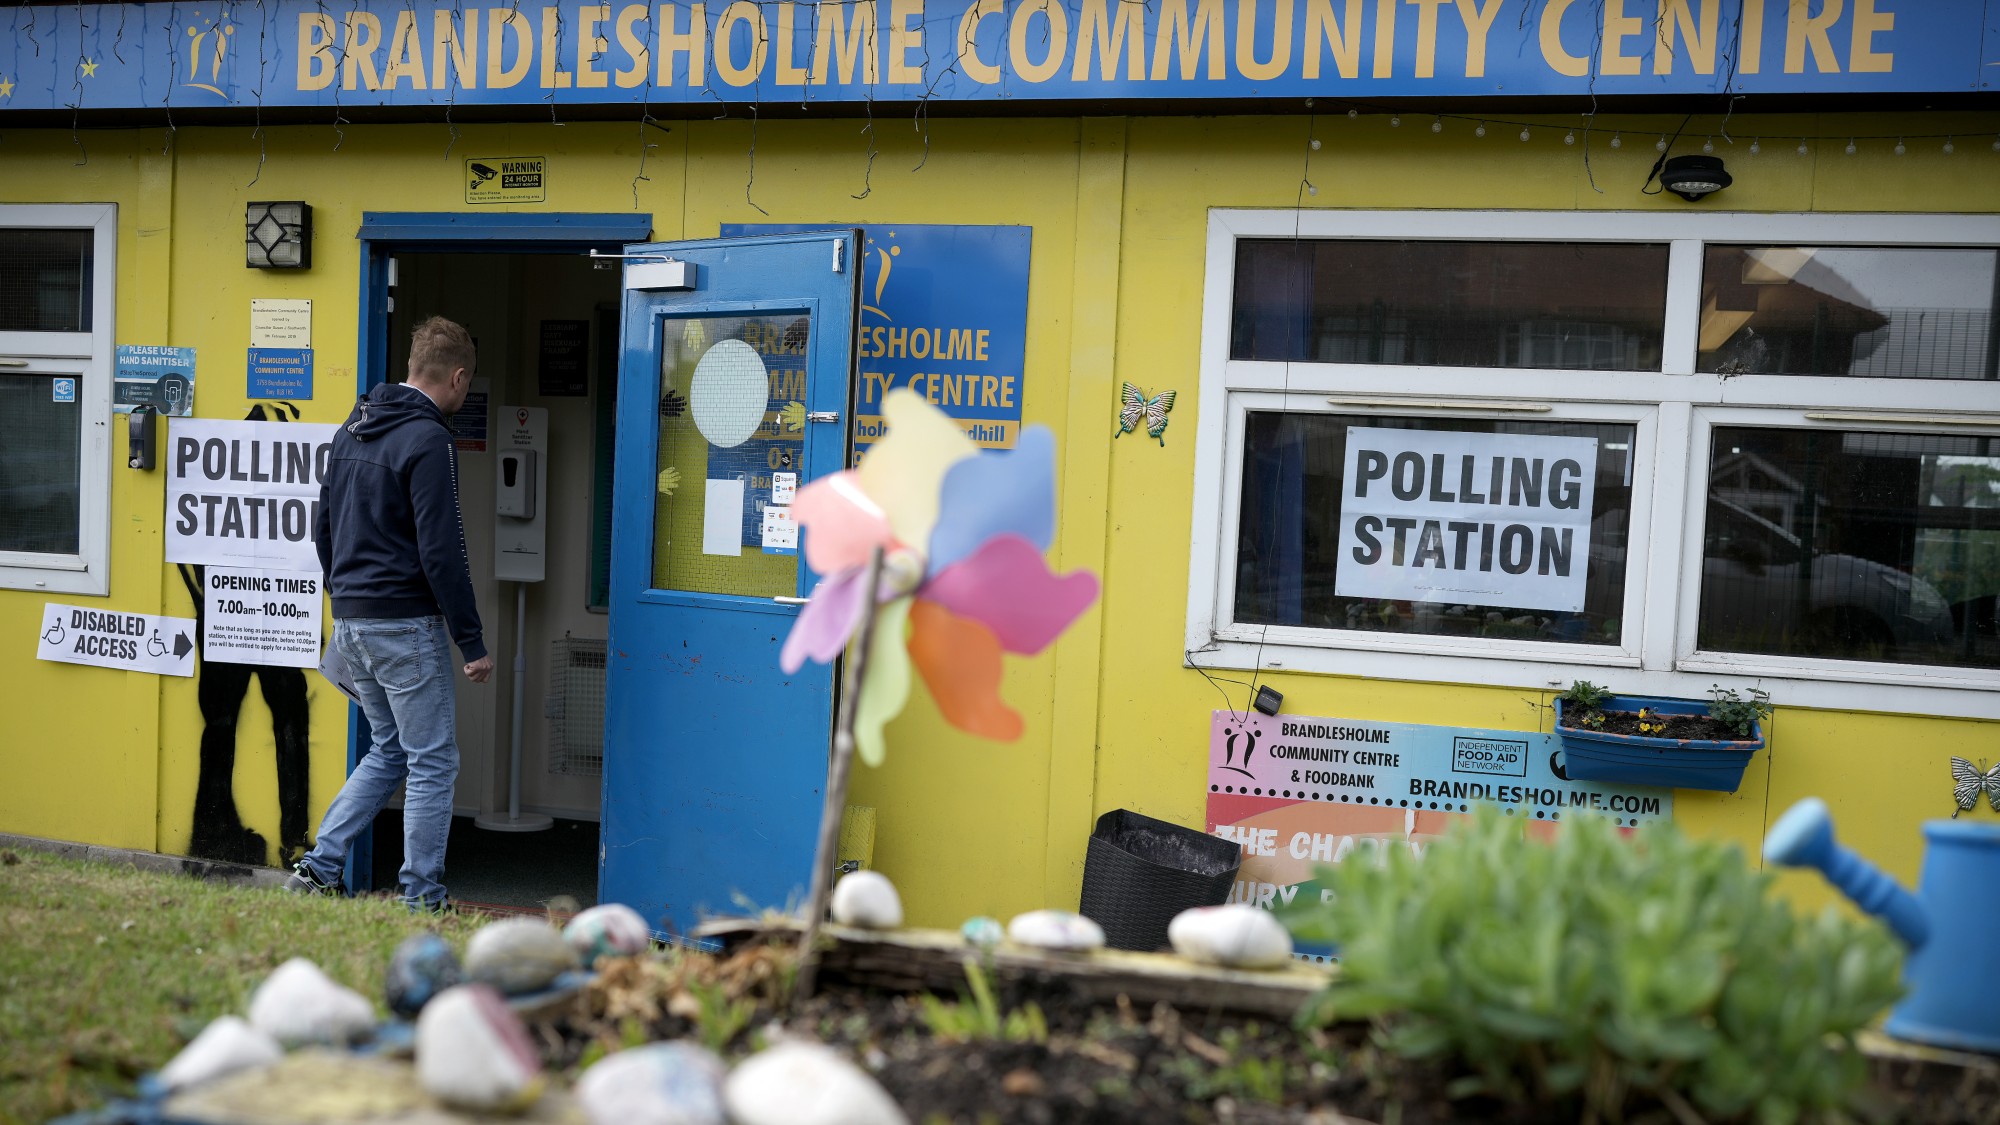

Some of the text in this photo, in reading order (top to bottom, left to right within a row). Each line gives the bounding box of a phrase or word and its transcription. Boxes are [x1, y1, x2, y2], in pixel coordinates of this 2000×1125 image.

[296, 0, 1895, 91] BRANDLESHOLME COMMUNITY CENTRE
[502, 162, 542, 173] WARNING
[505, 174, 539, 183] 24 HOUR
[129, 346, 179, 356] PLEASE USE
[119, 356, 190, 367] HAND SANITISER
[259, 357, 300, 365] BRANDLESHOLME
[286, 367, 305, 375] CENTRE
[1354, 449, 1582, 510] POLLING
[1352, 515, 1574, 577] STATION
[211, 574, 316, 594] OPENING TIMES
[70, 609, 146, 637] DISABLED
[208, 632, 227, 640] station,
[243, 626, 254, 634] long
[295, 630, 312, 638] polling
[73, 634, 138, 661] ACCESS
[1281, 722, 1391, 745] BRANDLESHOLME
[1457, 741, 1523, 753] INDEPENDENT
[1269, 744, 1401, 768] COMMUNITY CENTRE
[1457, 750, 1518, 763] FOOD AID
[1457, 760, 1505, 772] NETWORK
[1290, 769, 1376, 789] & FOODBANK
[1409, 778, 1661, 816] BRANDLESHOLME.COM
[1215, 825, 1278, 857] THE
